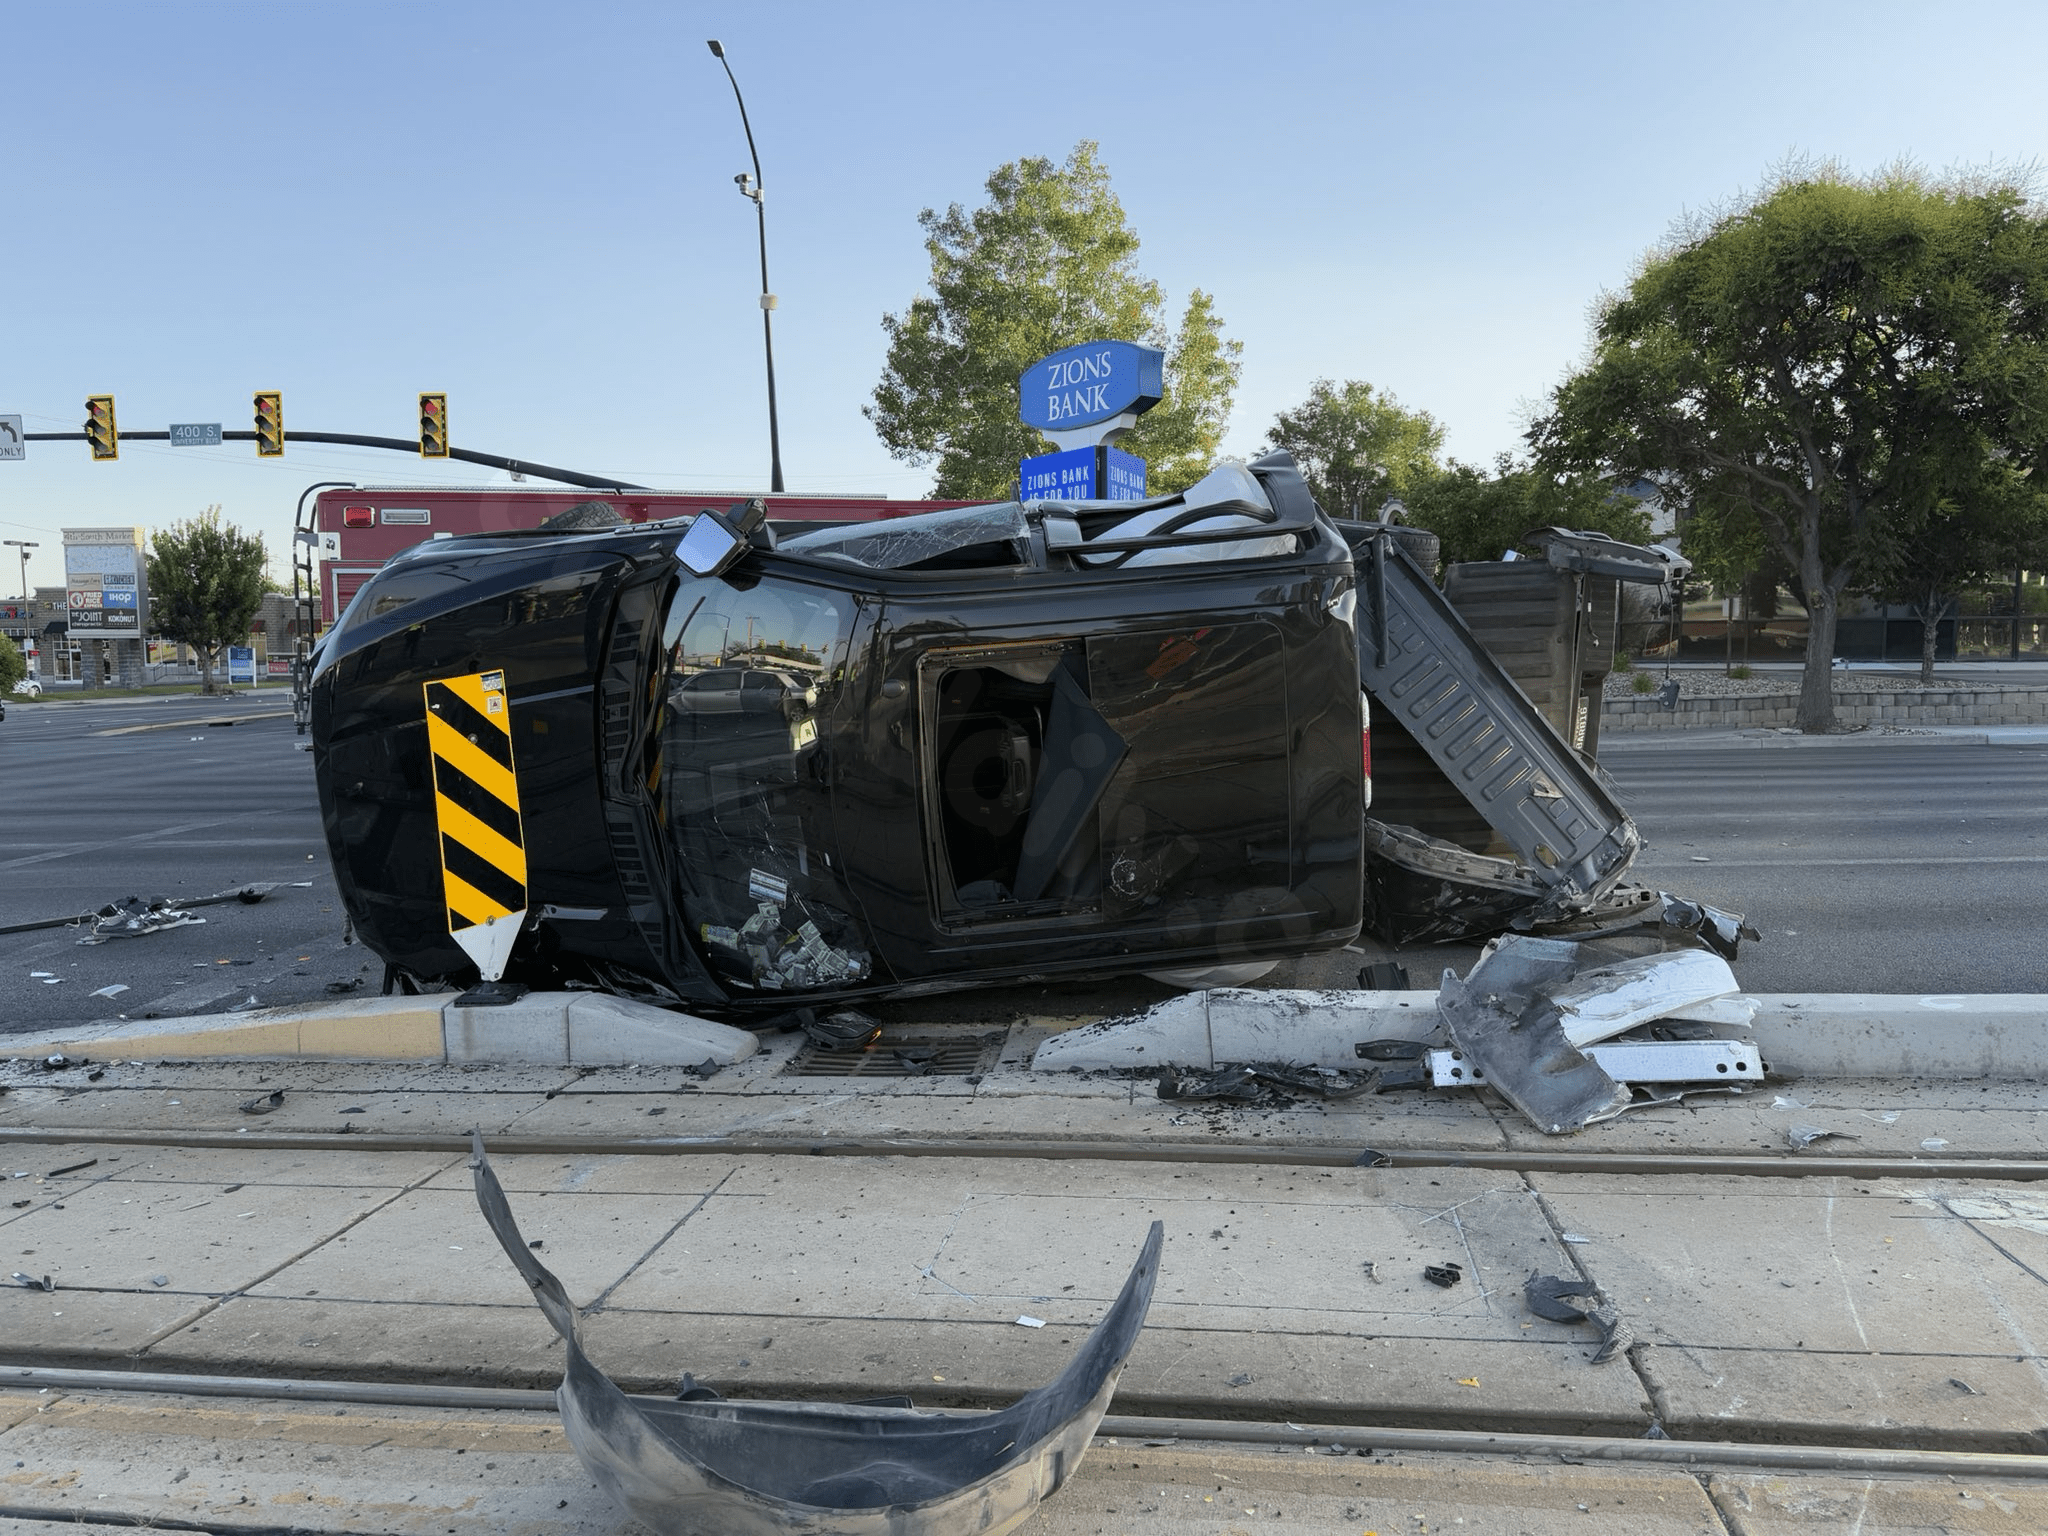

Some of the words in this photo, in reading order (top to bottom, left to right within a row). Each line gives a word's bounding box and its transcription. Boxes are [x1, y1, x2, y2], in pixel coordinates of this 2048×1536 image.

[1048, 351, 1112, 390] ZIONS
[1047, 383, 1110, 421] BANK
[176, 426, 201, 438] 400
[0, 447, 21, 456] ONLY
[1027, 471, 1057, 491] ZIONS
[1062, 465, 1089, 485] BANK
[1110, 465, 1128, 485] ZIONS
[1129, 472, 1144, 491] BANK
[1044, 488, 1063, 500] FOR
[1068, 483, 1087, 500] YOU
[109, 593, 132, 603] IHOP
[53, 602, 67, 610] THE
[79, 611, 103, 622] JOINT
